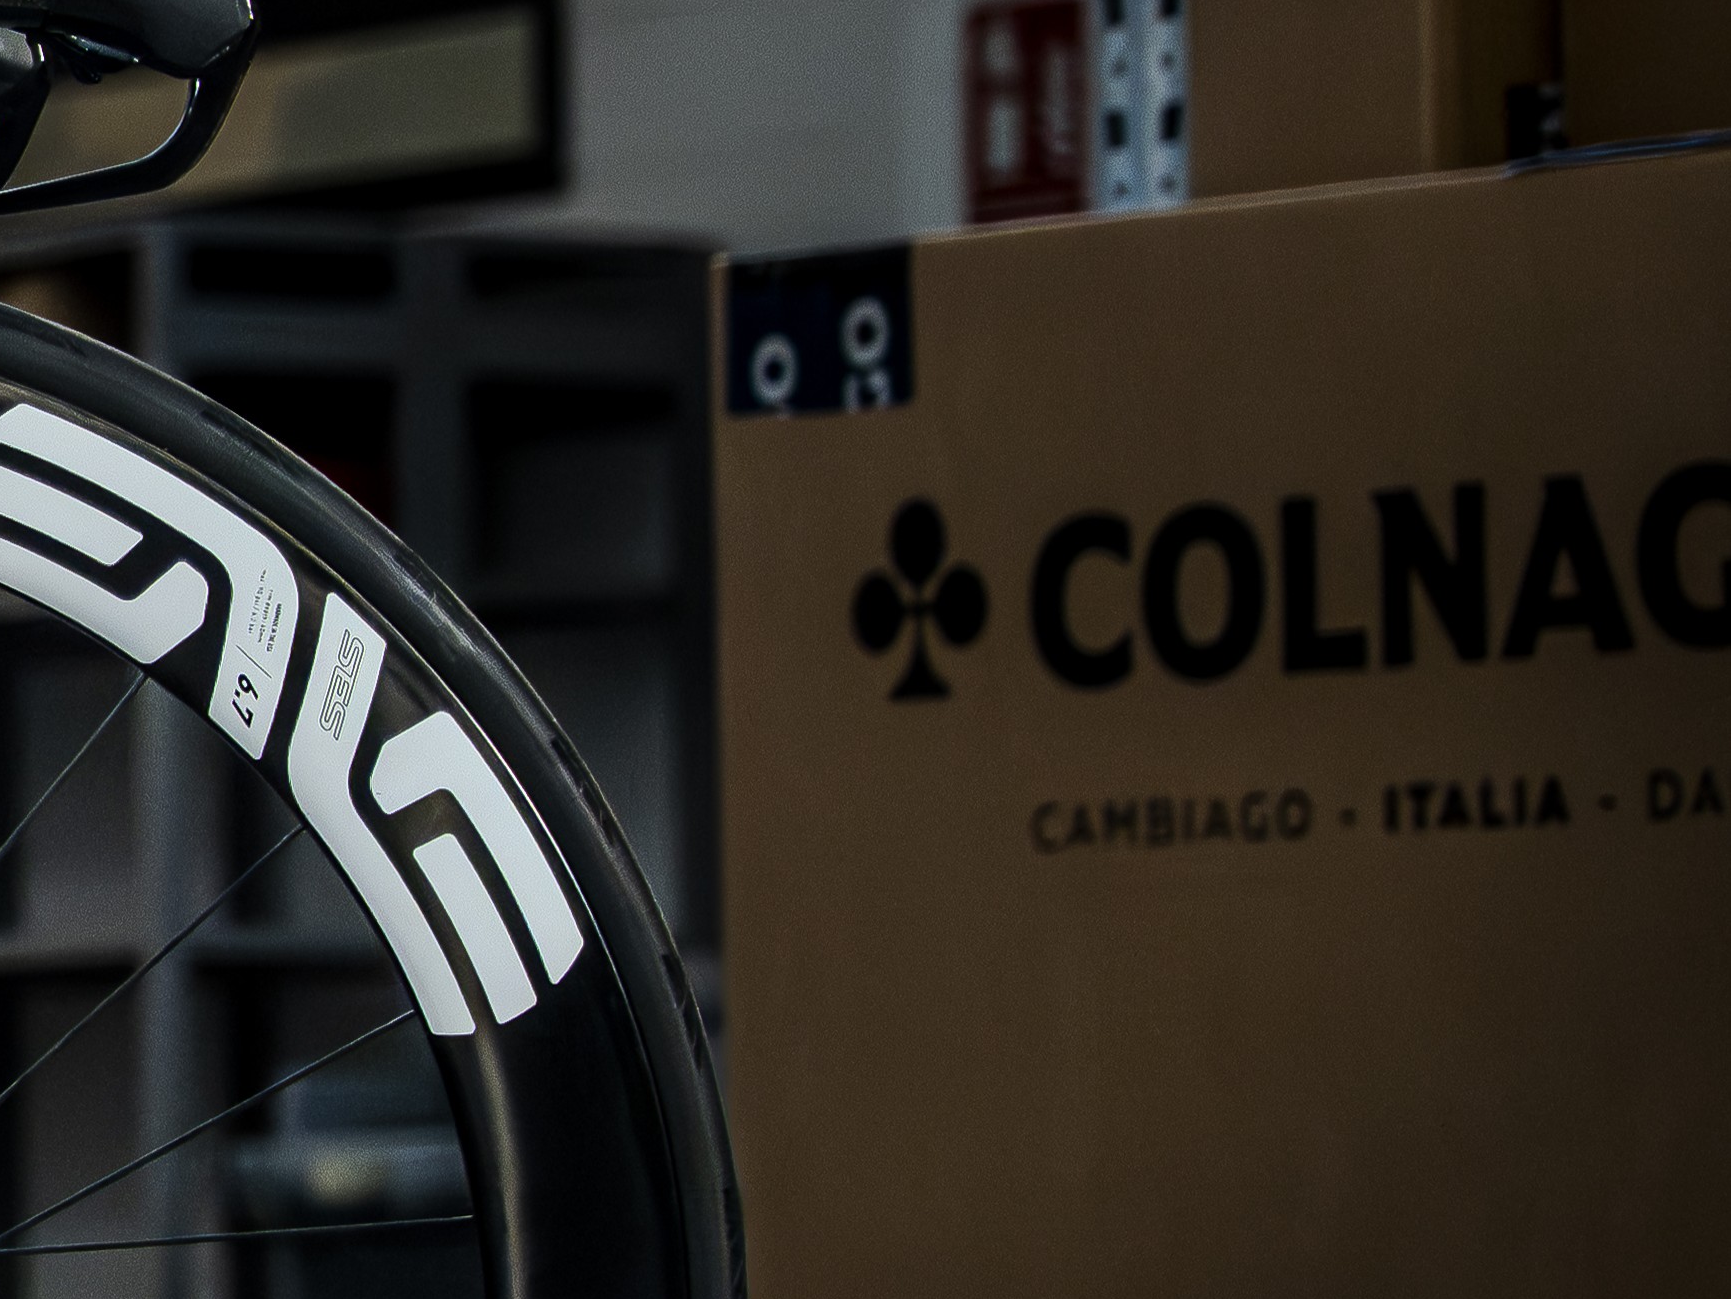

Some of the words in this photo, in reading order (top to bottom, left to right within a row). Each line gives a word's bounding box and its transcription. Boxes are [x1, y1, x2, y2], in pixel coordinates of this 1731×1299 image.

[231, 673, 259, 729] 6.7
[319, 628, 365, 741] SES
[1029, 789, 1313, 855] CAMBIAGO
[1383, 775, 1570, 833] ITALIA
